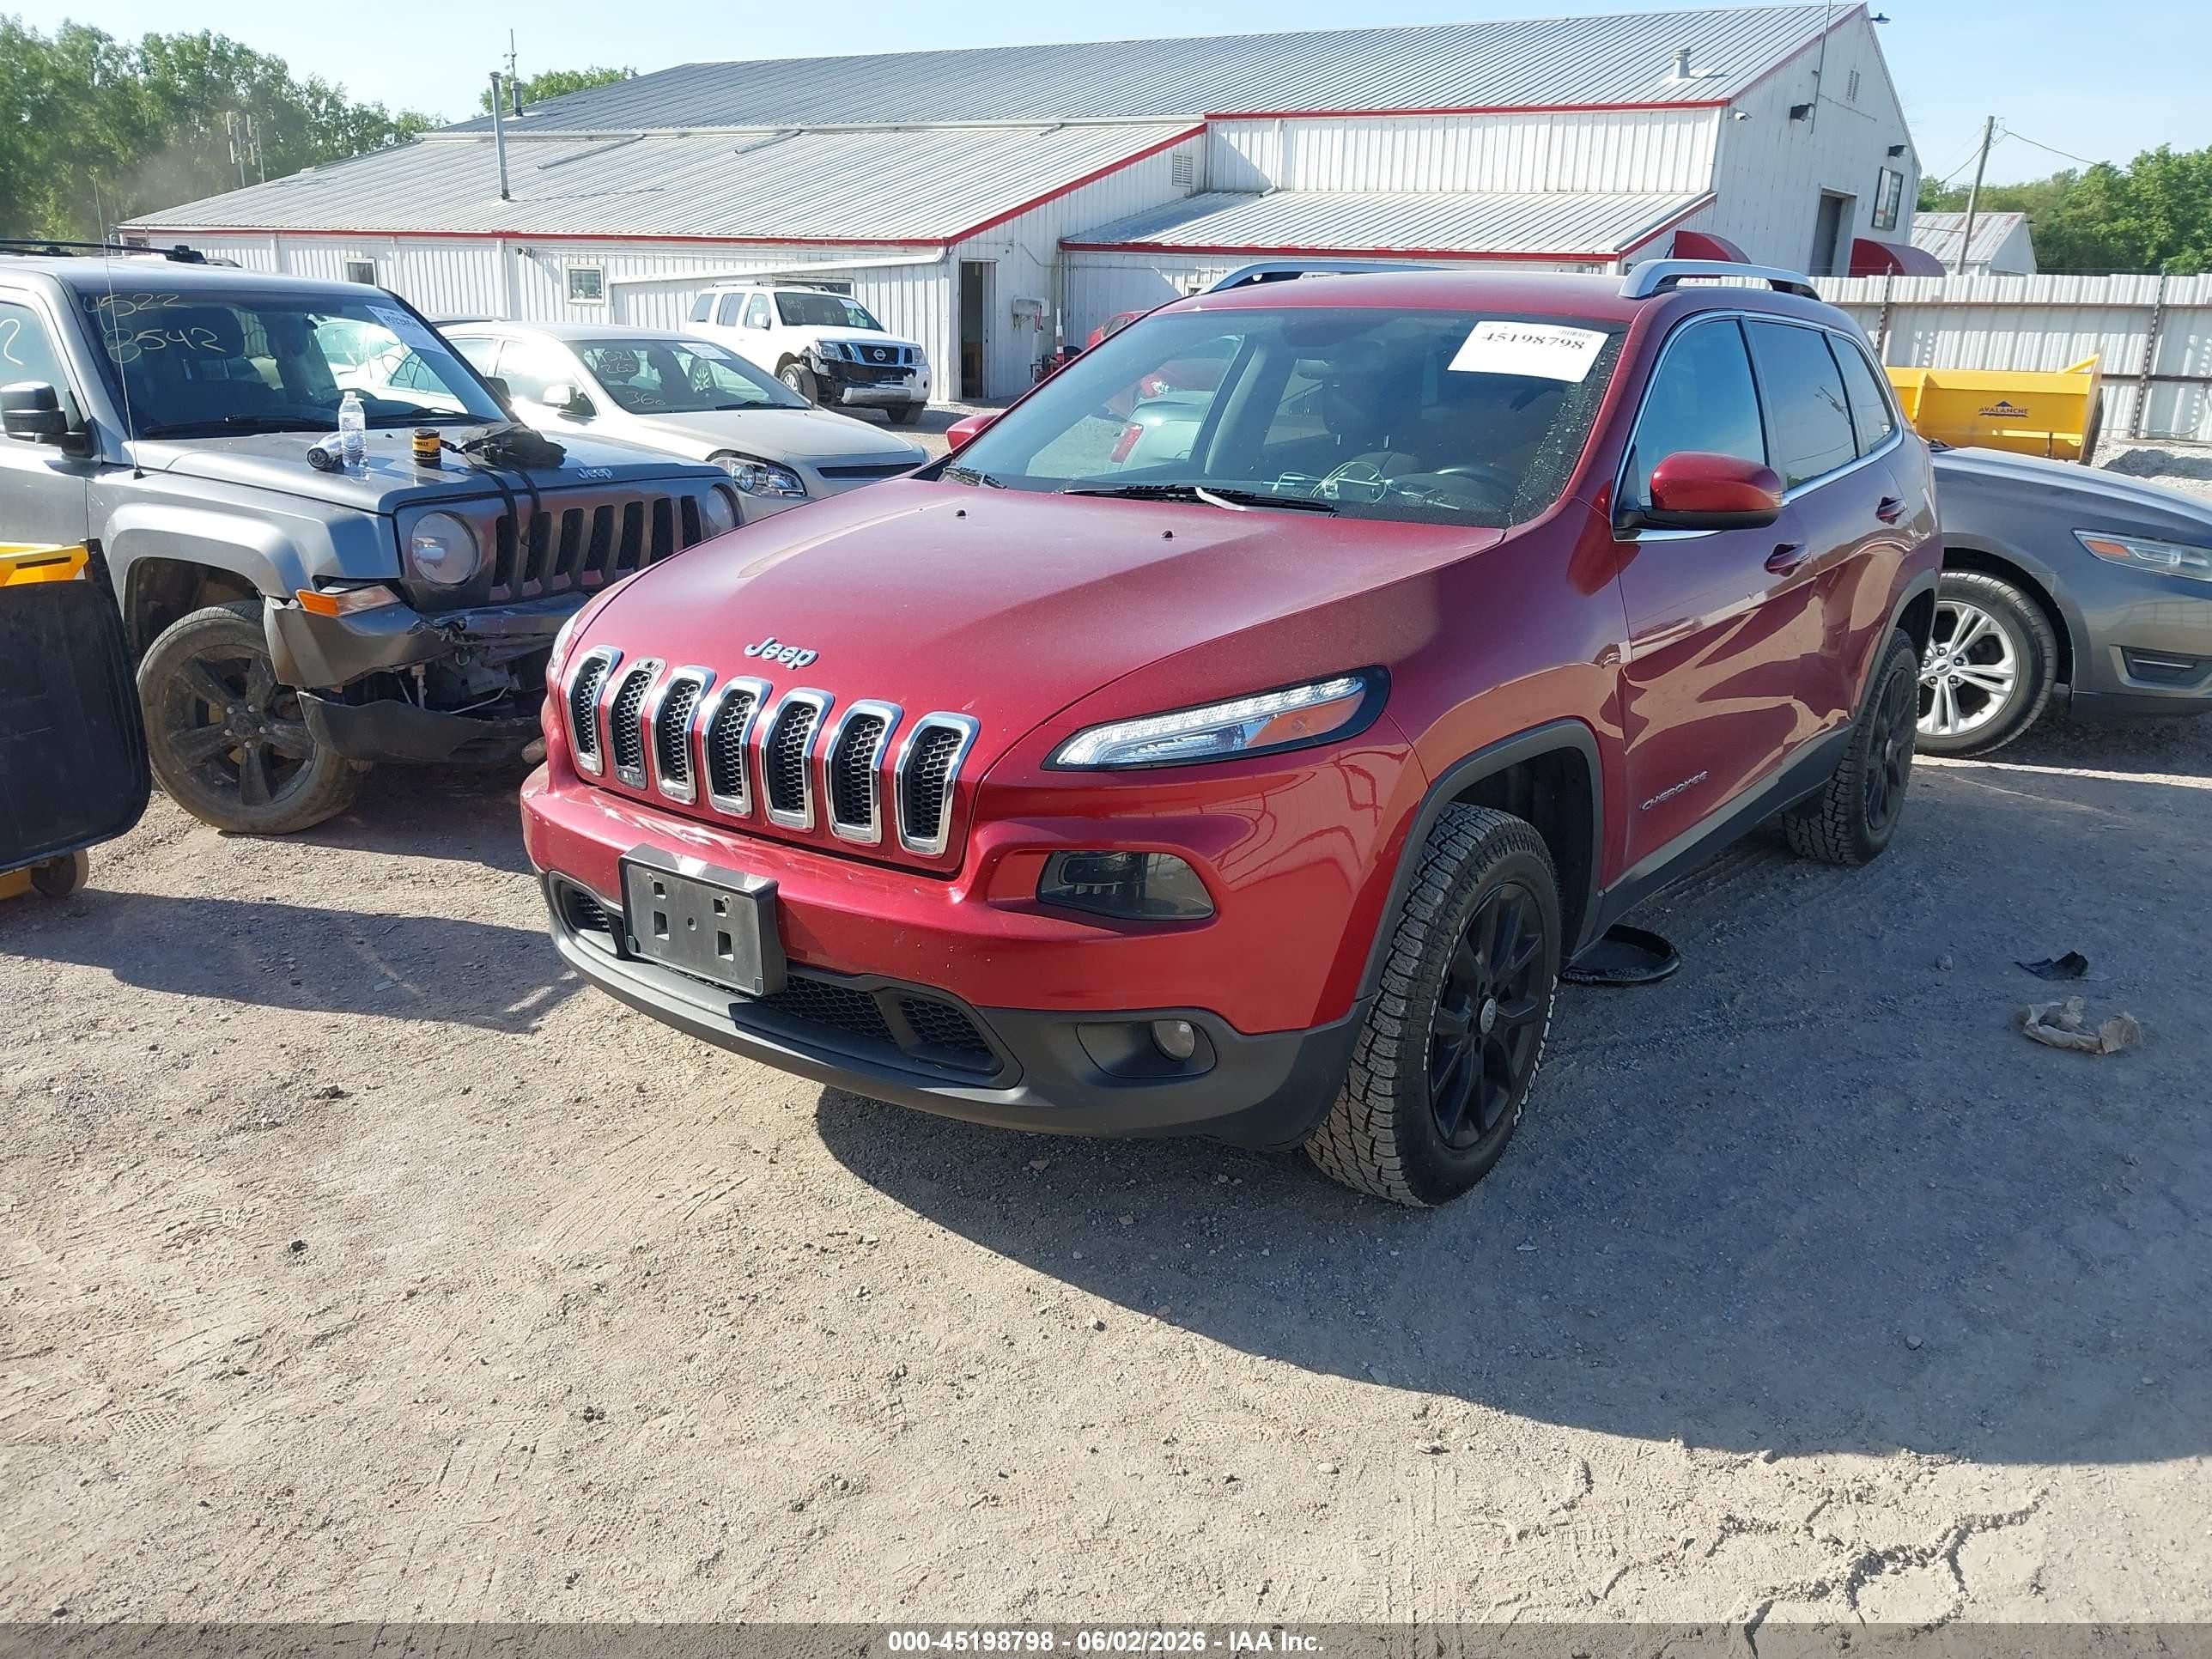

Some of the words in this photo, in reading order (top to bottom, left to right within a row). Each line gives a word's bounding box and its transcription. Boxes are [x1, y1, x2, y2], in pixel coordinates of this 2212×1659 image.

[83, 294, 193, 331] 4522
[103, 327, 227, 363] 8542
[1481, 331, 1585, 350] 45198798
[1978, 406, 2029, 415] AVALANCHE
[577, 467, 613, 480] Jeep
[744, 637, 820, 671] Jeep
[1640, 769, 1710, 811] CHEROKEE
[1512, 973, 1559, 1127] AMERICAN
